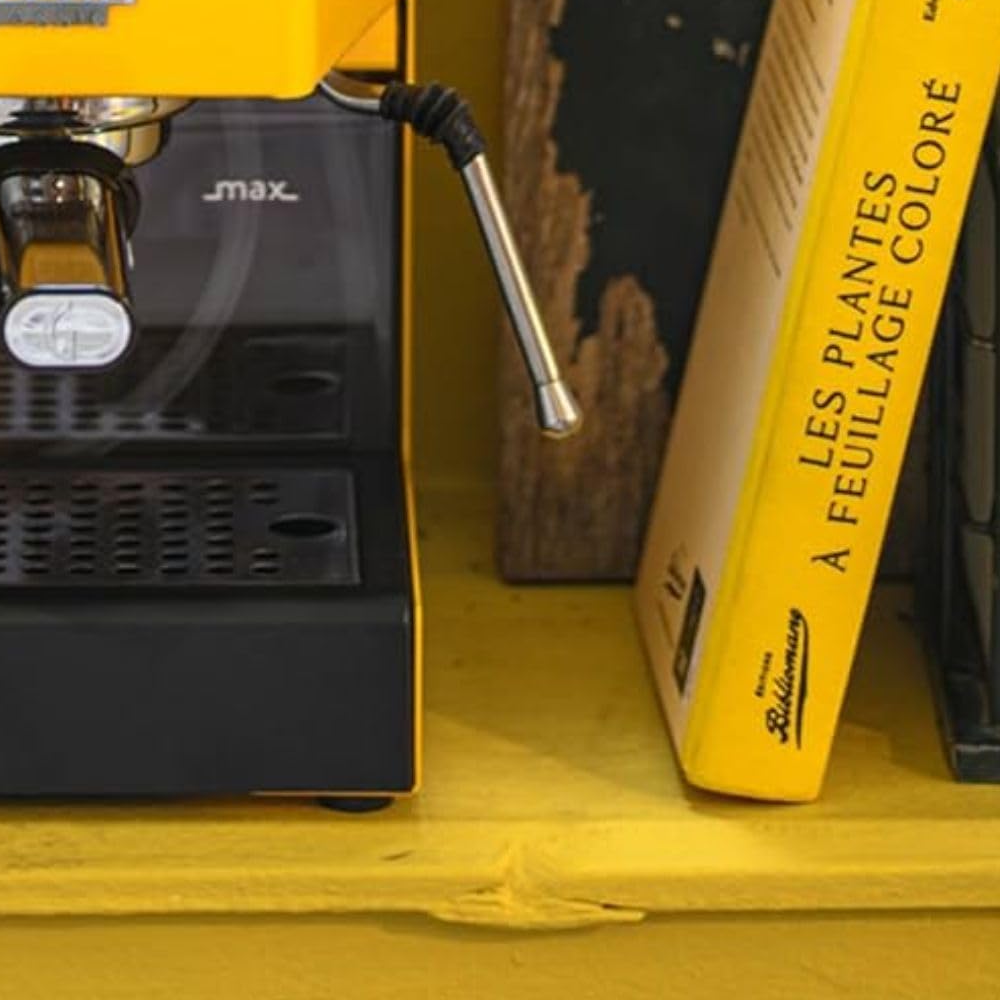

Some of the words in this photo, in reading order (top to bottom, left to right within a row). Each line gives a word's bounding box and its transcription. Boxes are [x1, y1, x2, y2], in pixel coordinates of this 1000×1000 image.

[889, 78, 961, 265] COLORÉ
[822, 170, 897, 369] PLANTES
[799, 388, 846, 468] LES
[827, 285, 913, 525] FEUILLAGE
[810, 548, 851, 573] À
